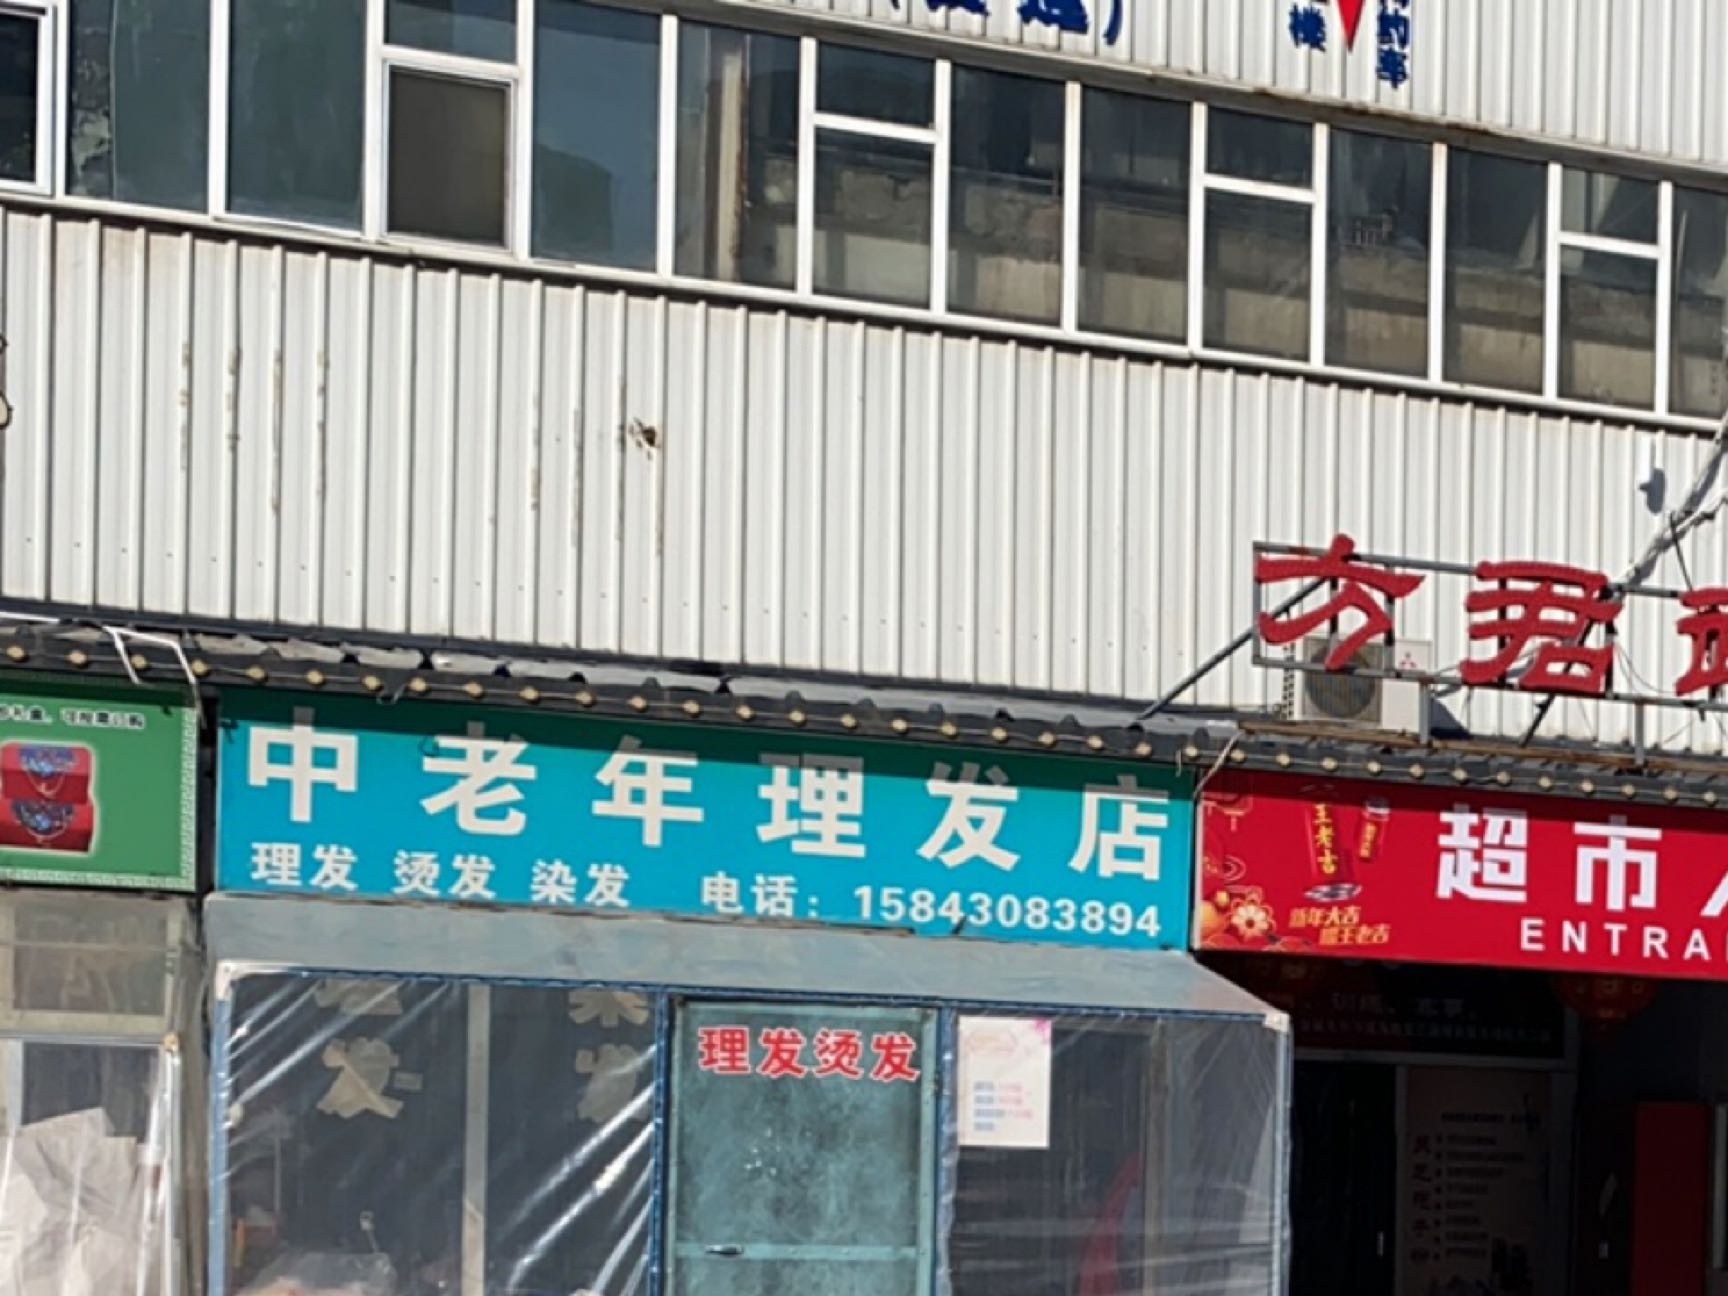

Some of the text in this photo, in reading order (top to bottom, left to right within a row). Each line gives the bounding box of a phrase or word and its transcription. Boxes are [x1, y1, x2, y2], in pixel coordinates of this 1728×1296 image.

[249, 706, 1168, 880] 中老年理发店
[251, 842, 358, 891] 理发
[392, 849, 497, 899] 烫发
[531, 858, 631, 908] 染发
[698, 1024, 921, 1083] 理发烫发
